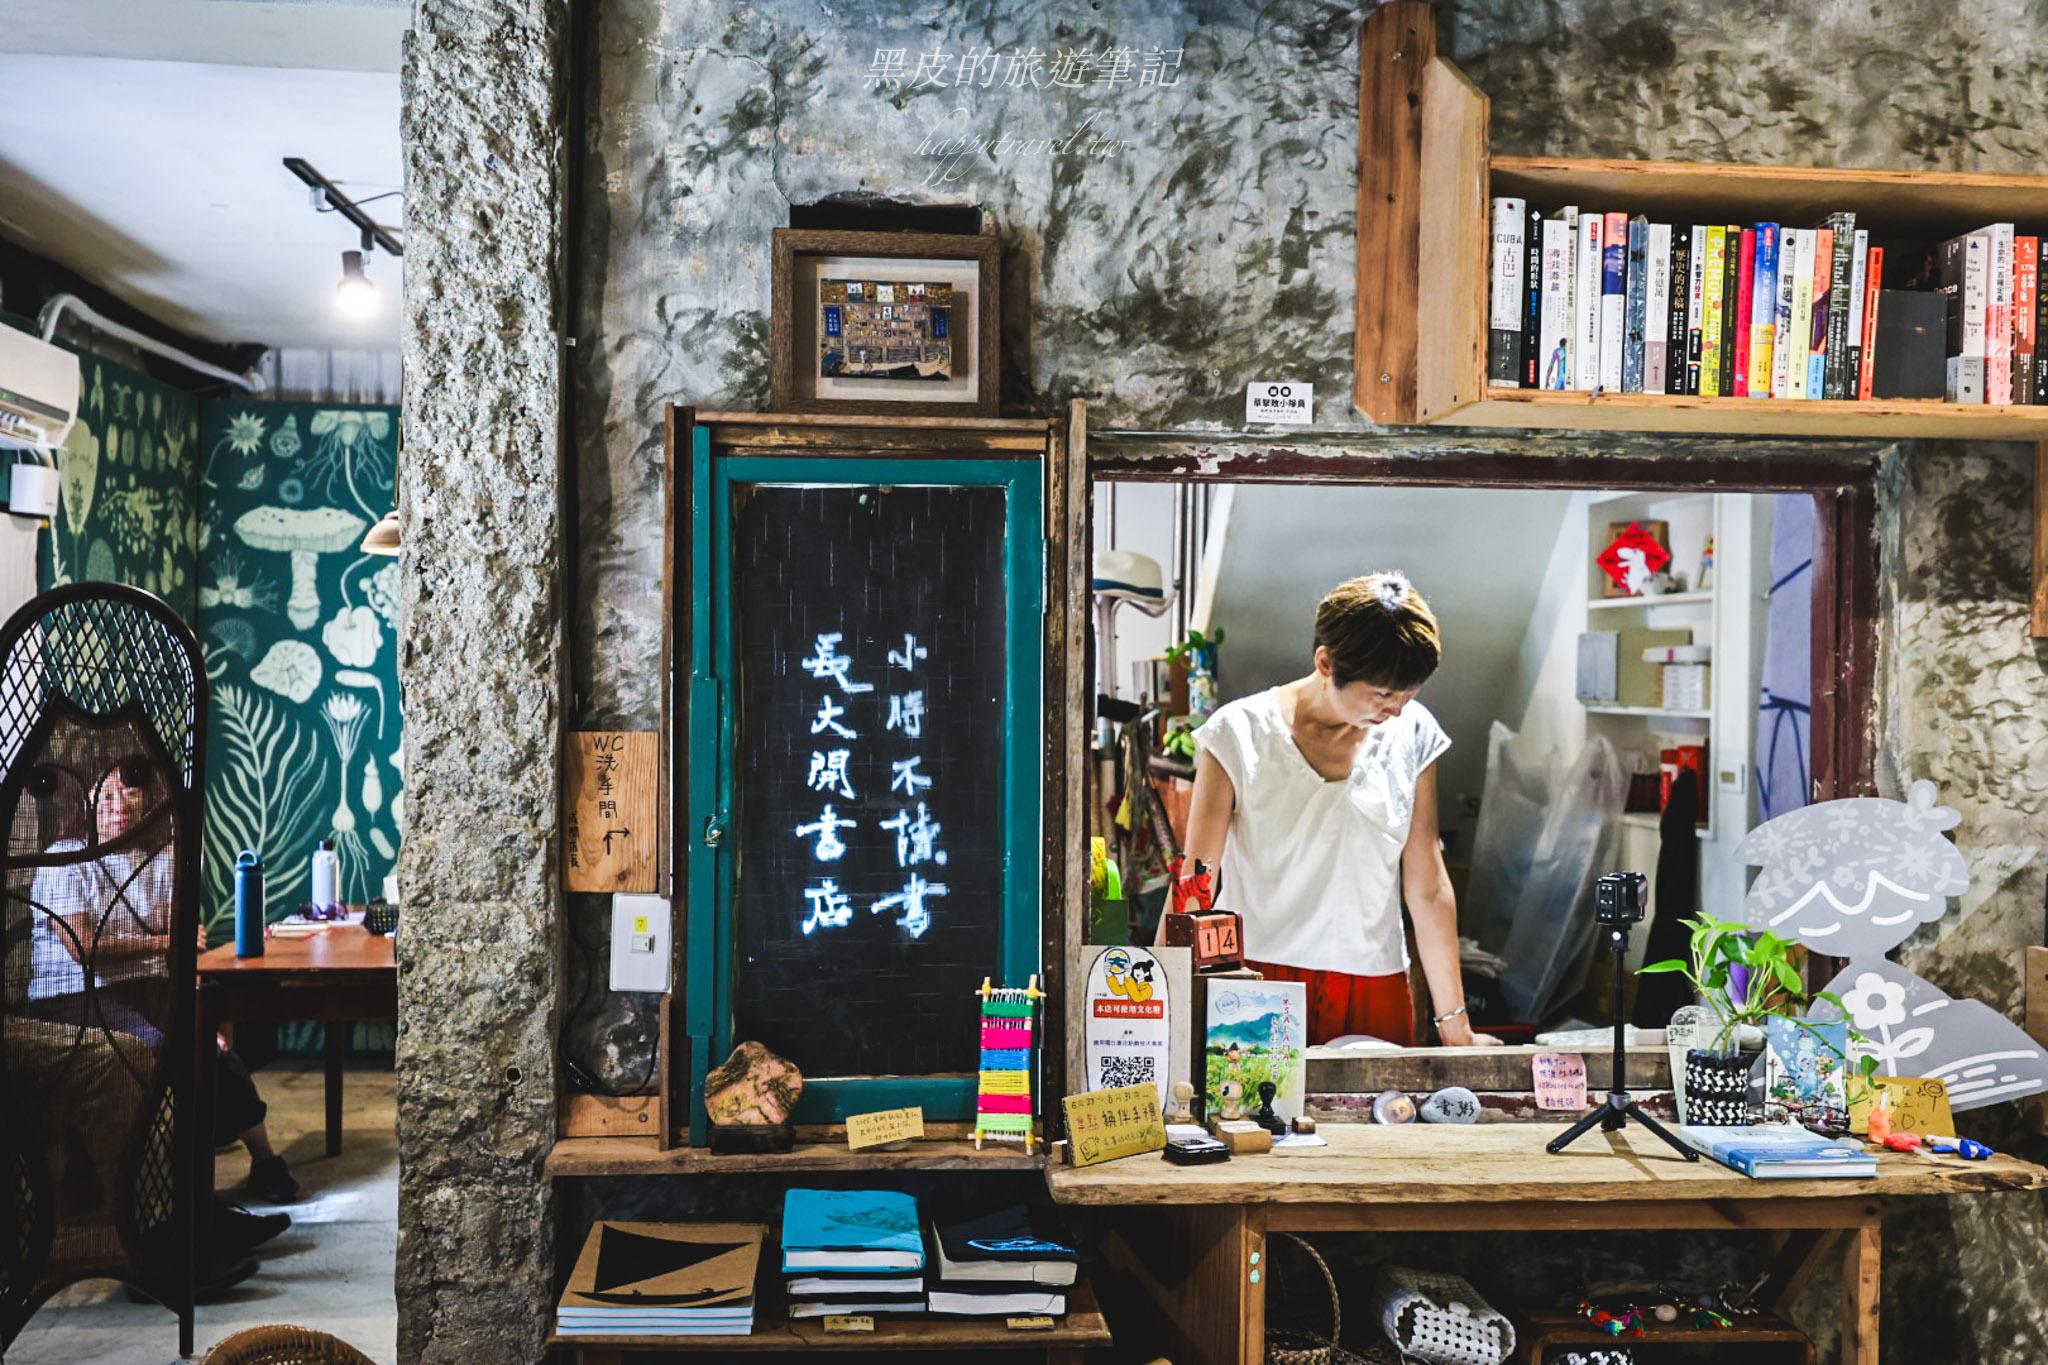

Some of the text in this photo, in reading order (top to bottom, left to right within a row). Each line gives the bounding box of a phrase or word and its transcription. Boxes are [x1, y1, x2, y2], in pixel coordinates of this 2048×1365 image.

[1496, 234, 1522, 245] CUBA
[1674, 249, 1686, 309] 歷史的草稿
[593, 735, 624, 752] WC
[596, 754, 619, 819] 洗手間
[796, 633, 874, 934] 長大開書店
